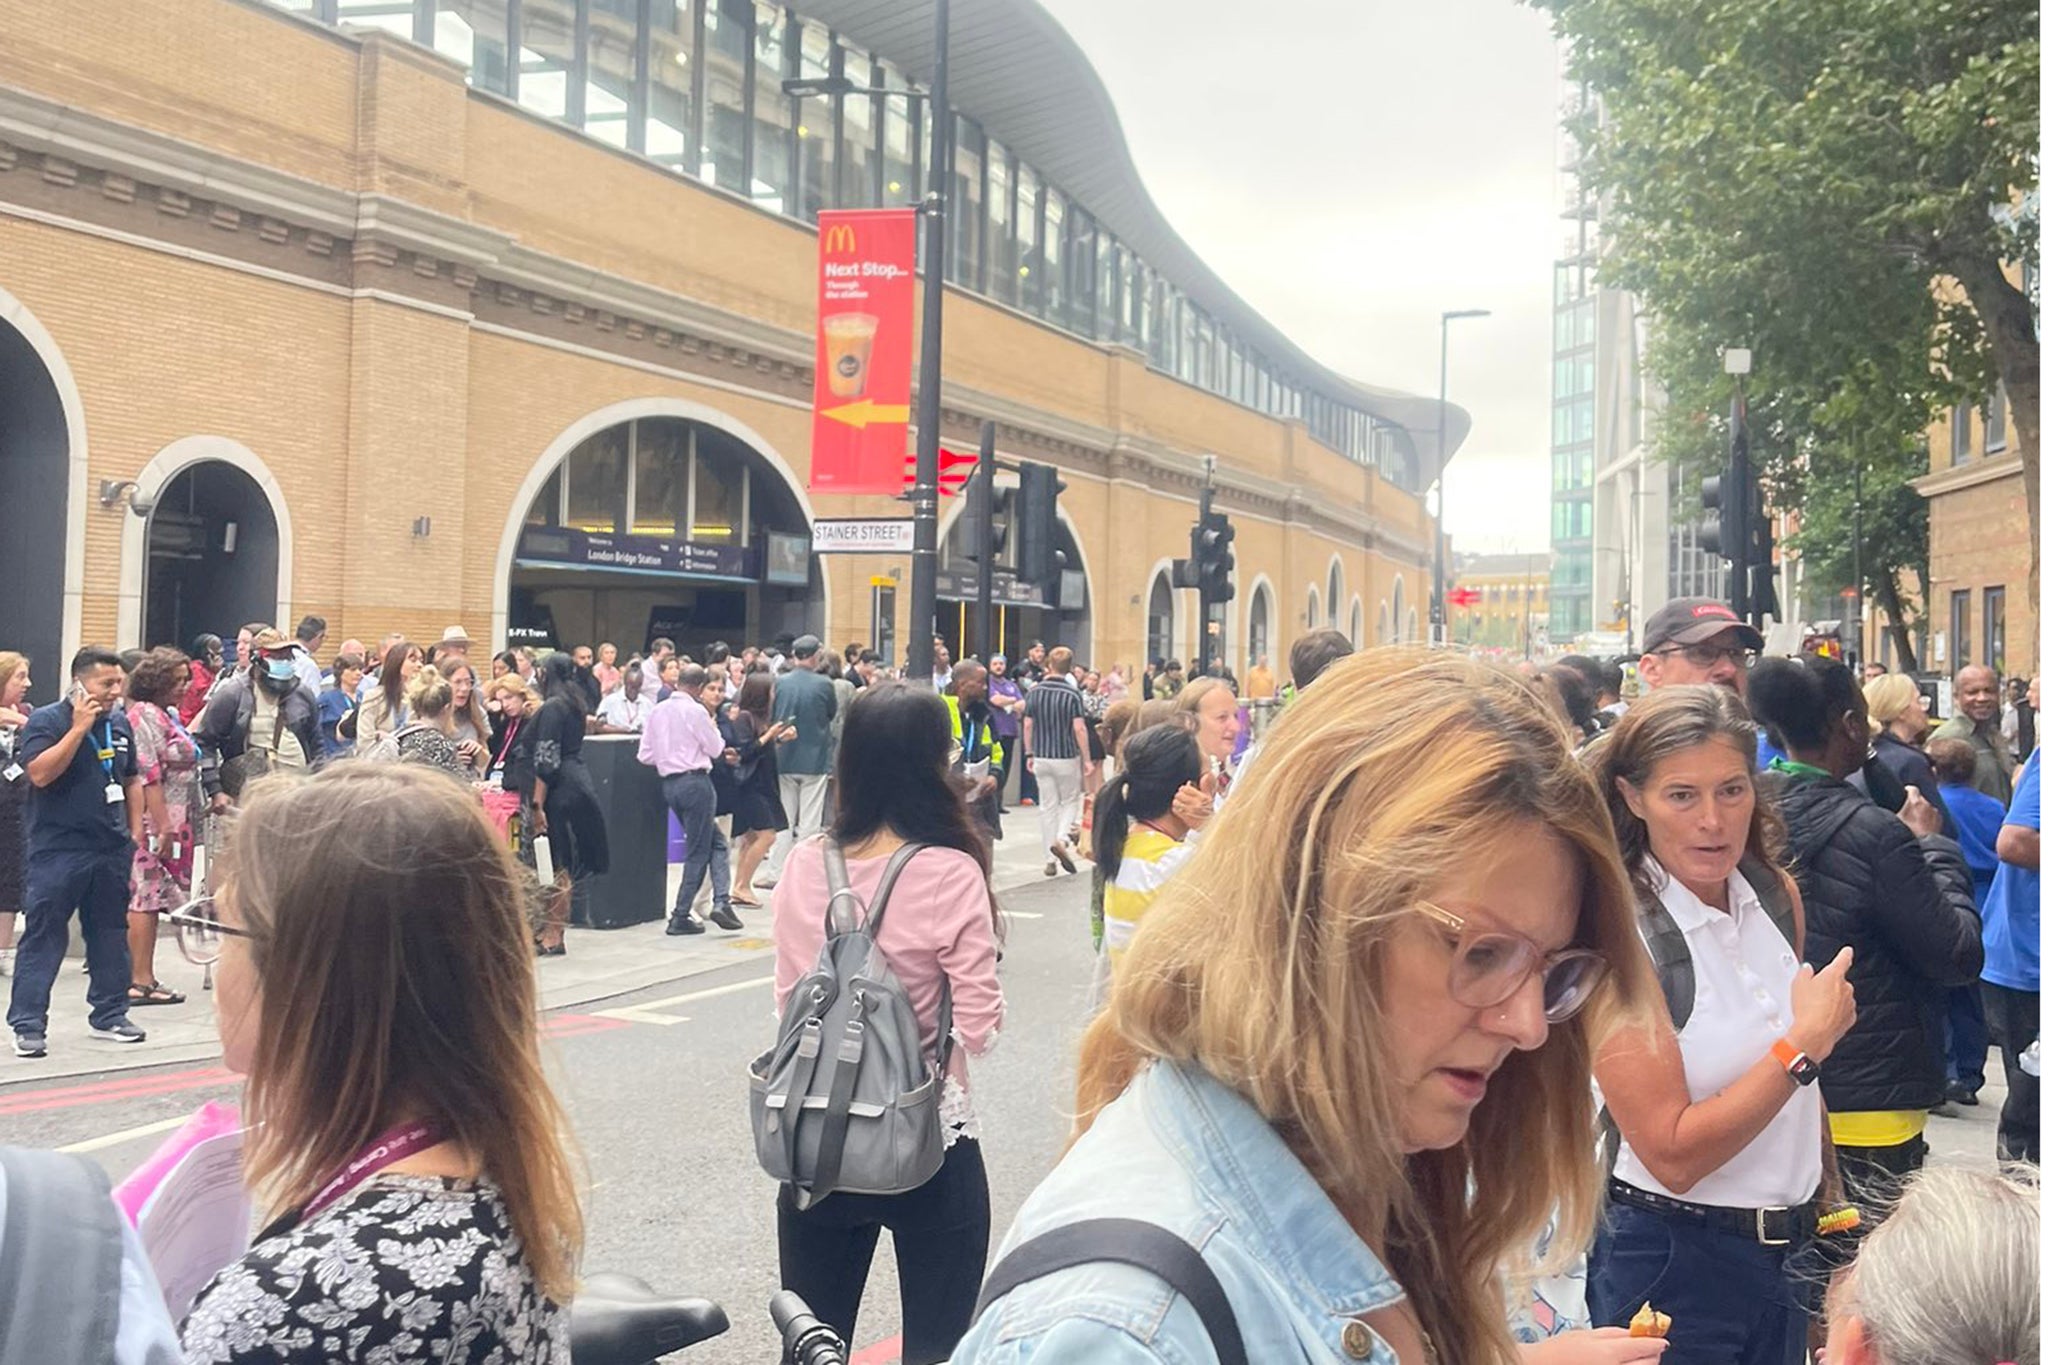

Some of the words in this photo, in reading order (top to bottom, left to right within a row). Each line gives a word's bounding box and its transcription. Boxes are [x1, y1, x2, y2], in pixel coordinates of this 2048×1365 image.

[825, 262, 859, 278] Next
[815, 526, 859, 540] STAINER
[860, 525, 902, 540] STREET
[587, 549, 614, 561] London
[615, 551, 637, 565] Bridge
[638, 553, 662, 565] Station
